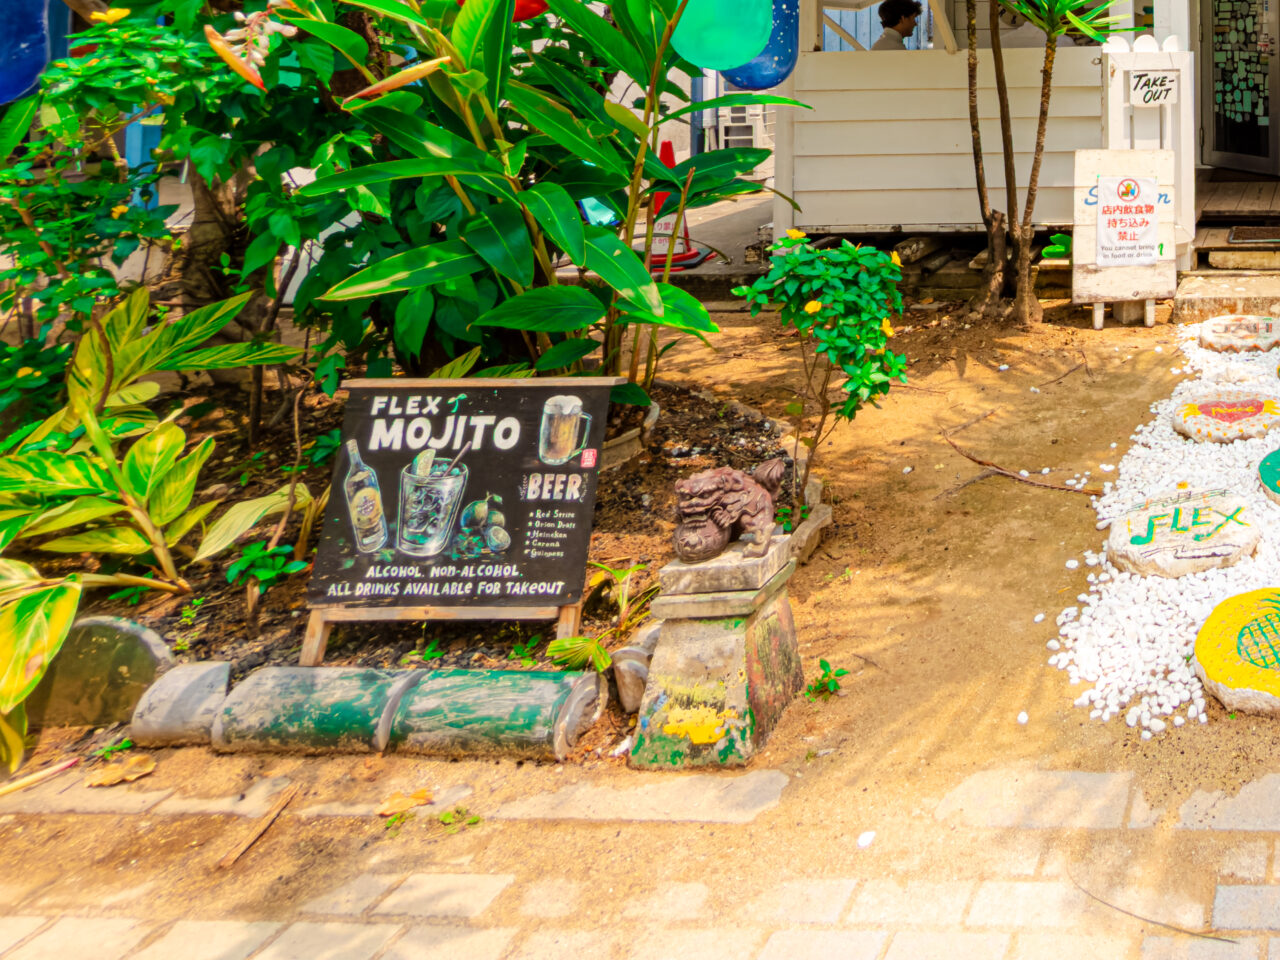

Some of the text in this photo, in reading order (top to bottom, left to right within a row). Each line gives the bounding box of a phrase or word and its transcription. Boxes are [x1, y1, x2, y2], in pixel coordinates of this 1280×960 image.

[1133, 73, 1175, 91] TAKE-
[1143, 87, 1172, 104] OUT
[1102, 204, 1155, 215] 店内飲食物
[1107, 218, 1150, 228] 持ち込み
[1117, 231, 1140, 241] 禁止
[370, 395, 442, 416] FLEX
[368, 415, 521, 450] MOJITO
[527, 473, 583, 500] BEER
[535, 509, 551, 518] Red
[534, 520, 555, 528] Orion
[327, 582, 351, 596] ALL
[477, 581, 501, 594] FOR
